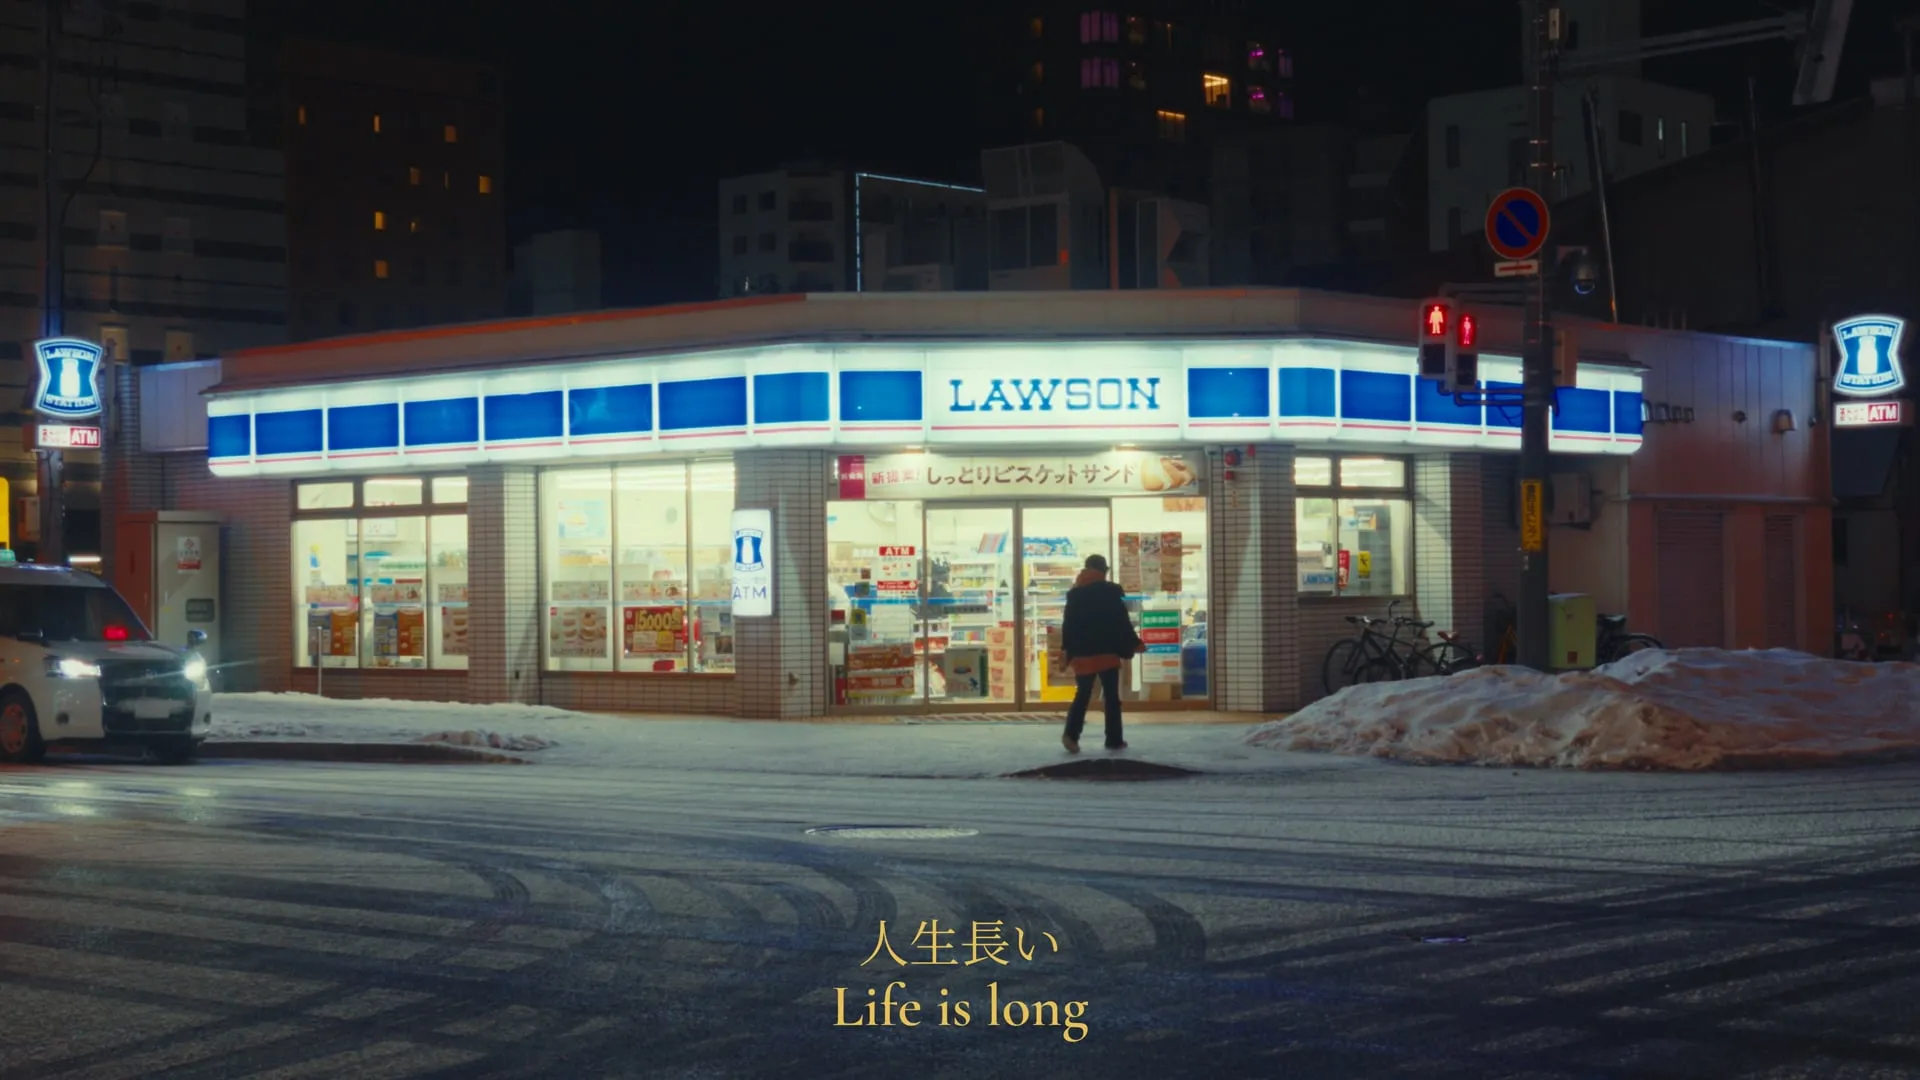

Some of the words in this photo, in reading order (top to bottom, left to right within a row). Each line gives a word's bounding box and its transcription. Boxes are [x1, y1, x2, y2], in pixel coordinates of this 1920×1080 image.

[949, 377, 1160, 412] LAWSON
[1870, 405, 1897, 421] ATM
[71, 429, 98, 444] ATM
[927, 463, 1136, 485] しっとりビスケットサンド
[884, 546, 910, 556] ATM
[732, 586, 767, 600] ATM
